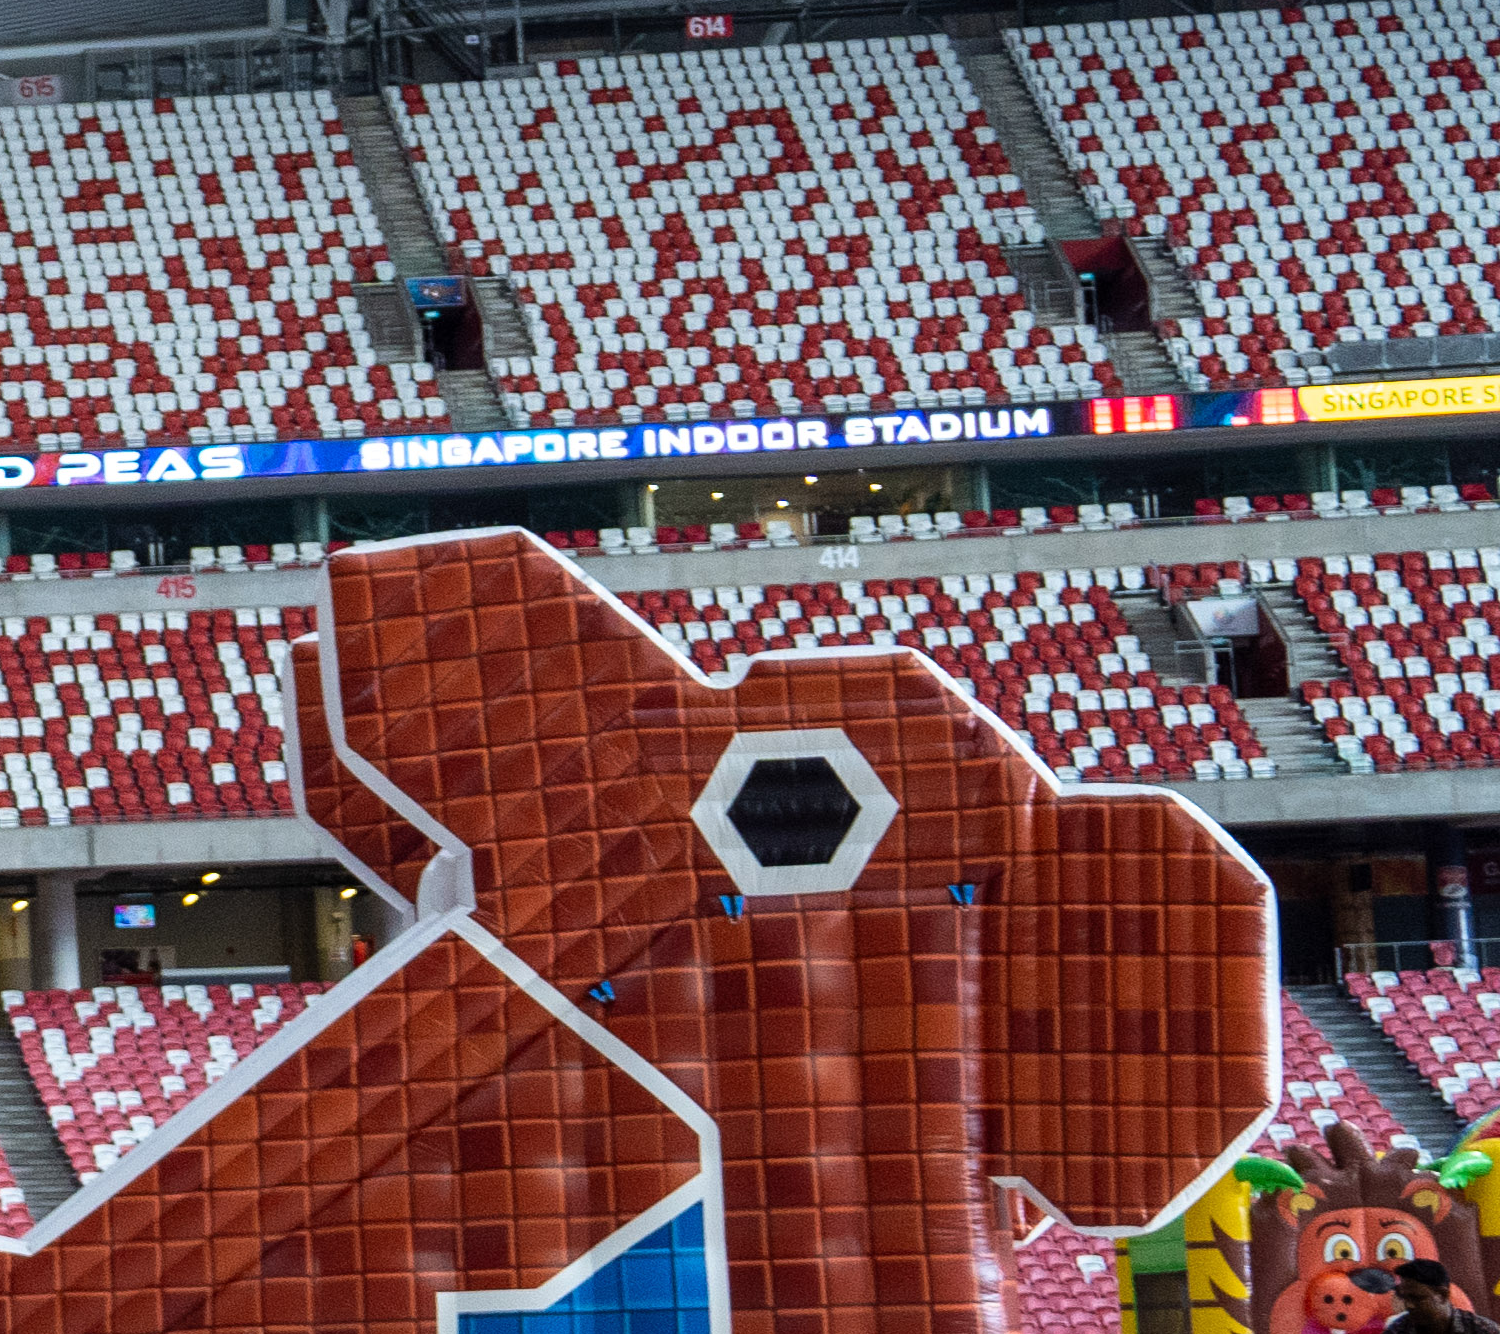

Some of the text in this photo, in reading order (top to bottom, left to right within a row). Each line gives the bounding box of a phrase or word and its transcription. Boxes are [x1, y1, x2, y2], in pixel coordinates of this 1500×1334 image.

[689, 15, 726, 37] 614
[20, 76, 55, 98] 615
[1323, 385, 1500, 413] SINGAPORE S
[360, 408, 1049, 470] SINGAPORE INDOOR STADIUM
[56, 445, 245, 486] PEAS
[819, 545, 860, 569] 414
[155, 575, 197, 599] 415
